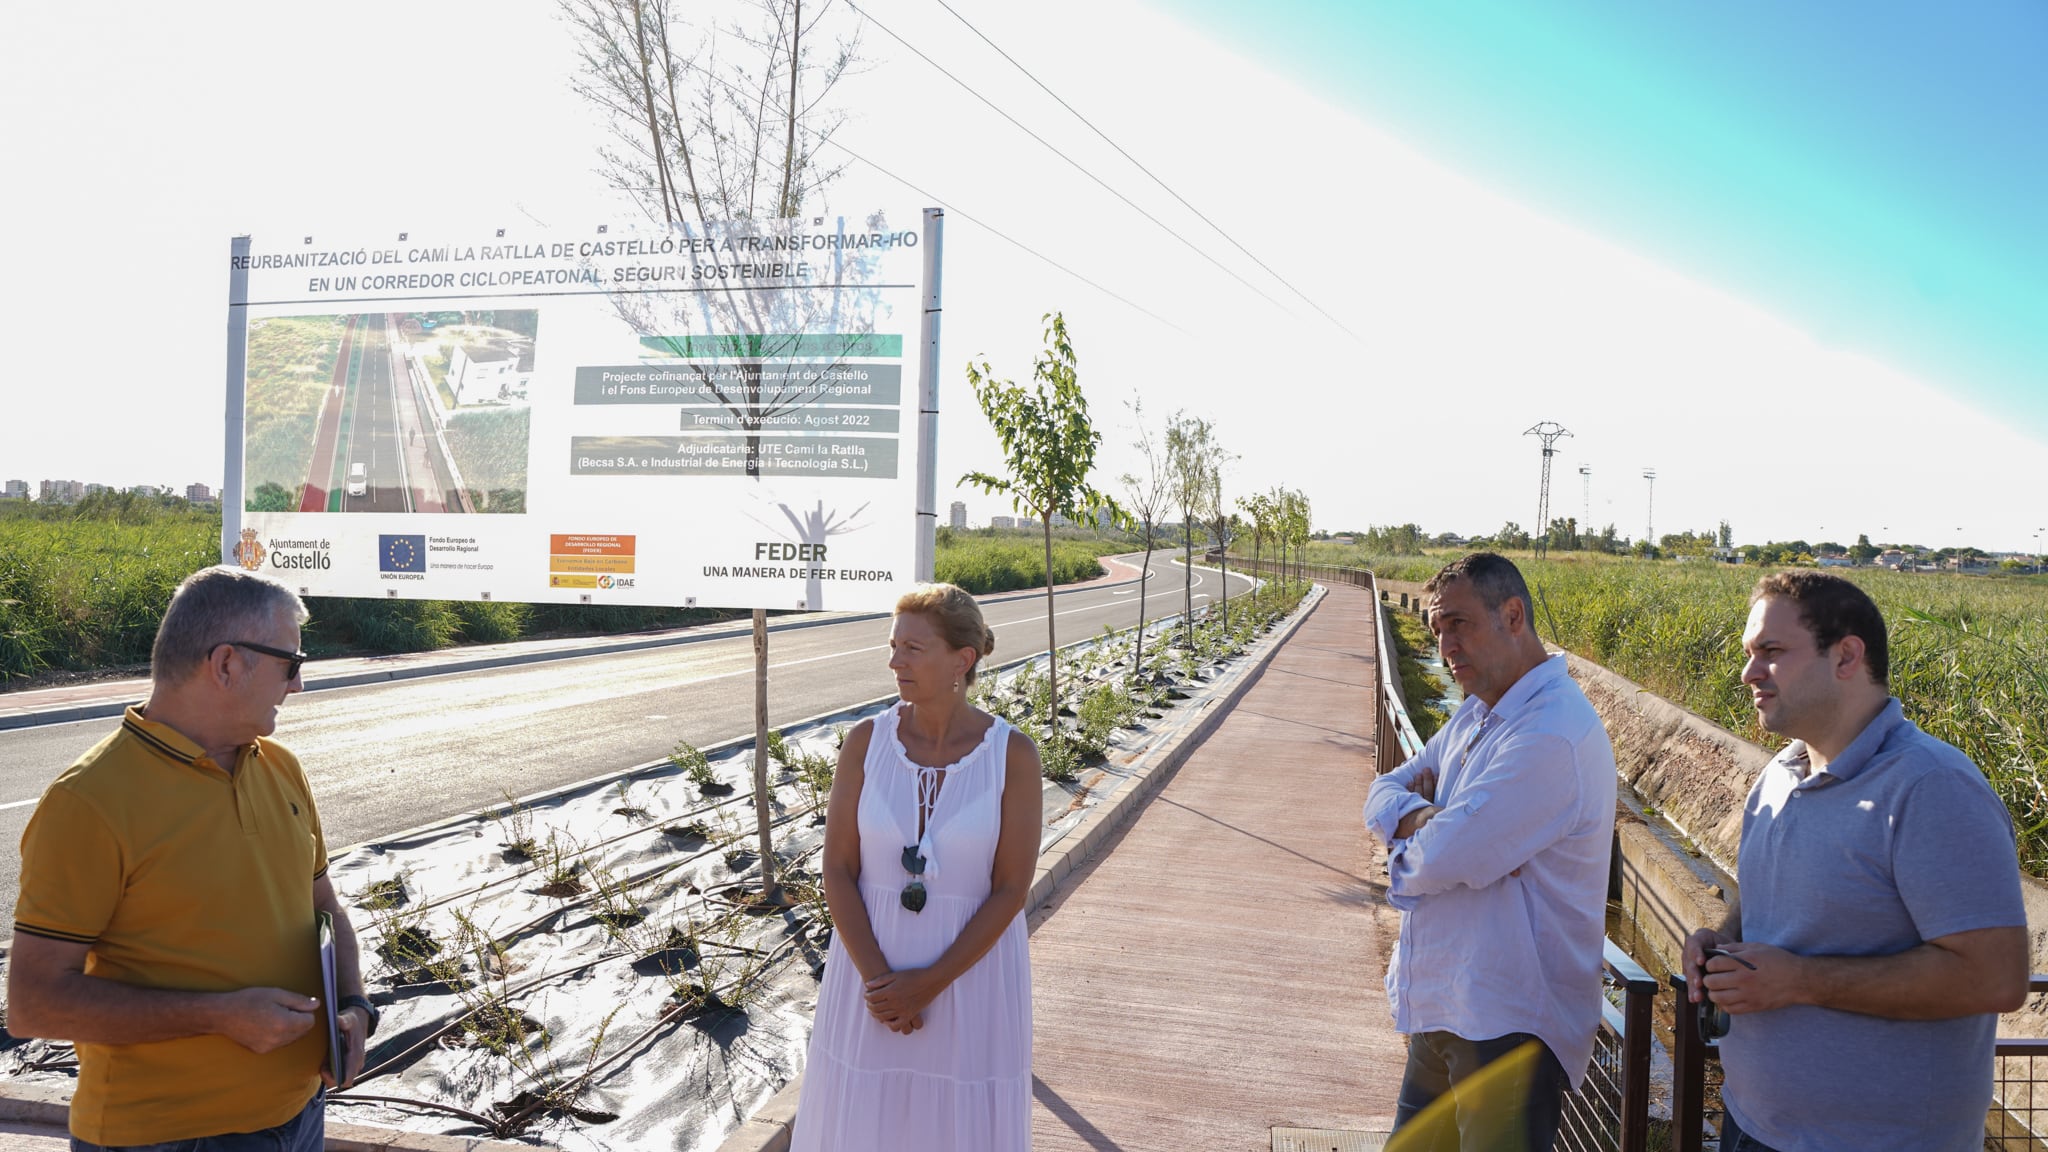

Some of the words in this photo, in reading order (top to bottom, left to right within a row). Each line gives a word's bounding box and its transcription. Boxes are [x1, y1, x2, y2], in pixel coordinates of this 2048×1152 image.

[231, 248, 367, 270] REURBANITZACIÓ
[372, 249, 403, 264] DEL
[408, 244, 449, 263] CAMÍ
[454, 247, 475, 261] LA
[480, 244, 546, 260] RATLLA
[551, 243, 574, 258] DE
[580, 236, 674, 256] CASTELLÓ
[679, 238, 716, 254] PER
[719, 237, 733, 252] A
[738, 231, 918, 251] TRANSFORMAR-HO
[309, 277, 330, 292] EN
[335, 276, 357, 291] UN
[361, 273, 455, 290] CORREDOR
[460, 268, 607, 287] CICLOPEATONAL,
[614, 266, 676, 282] SEGUR
[691, 262, 809, 280] SOSTENIBLE
[602, 372, 646, 384] Projecte
[649, 371, 706, 383] cofinançat
[709, 372, 727, 383] per
[730, 370, 800, 382] l'Ajuntament
[803, 371, 818, 381] de
[820, 370, 868, 381] Castelló
[608, 385, 617, 395] el
[620, 385, 646, 395] Fons
[649, 384, 695, 396] Europeu
[698, 384, 712, 394] de
[715, 383, 816, 395] Desenvolupament
[819, 384, 871, 396] Regional
[693, 414, 734, 425] Termini
[737, 414, 801, 425] d'execució:
[804, 415, 839, 427] Agost
[842, 415, 870, 425] 2022
[758, 444, 782, 454] UTE
[818, 444, 828, 455] la
[831, 444, 865, 455] Ratlla
[578, 457, 614, 469] (Becsa
[617, 457, 638, 467] S.A.
[641, 459, 648, 467] e
[651, 457, 702, 467] Industrial
[705, 457, 719, 467] de
[841, 458, 868, 472] S.L.)
[269, 538, 318, 550] Ajuntament
[320, 538, 330, 549] de
[755, 542, 828, 562] FEDER
[271, 550, 330, 570] Castelló
[703, 566, 728, 577] UNA
[732, 567, 785, 578] MANERA
[789, 568, 807, 579] DE
[811, 568, 836, 580] FER
[840, 570, 893, 582] EUROPA
[617, 578, 635, 586] IDAE
